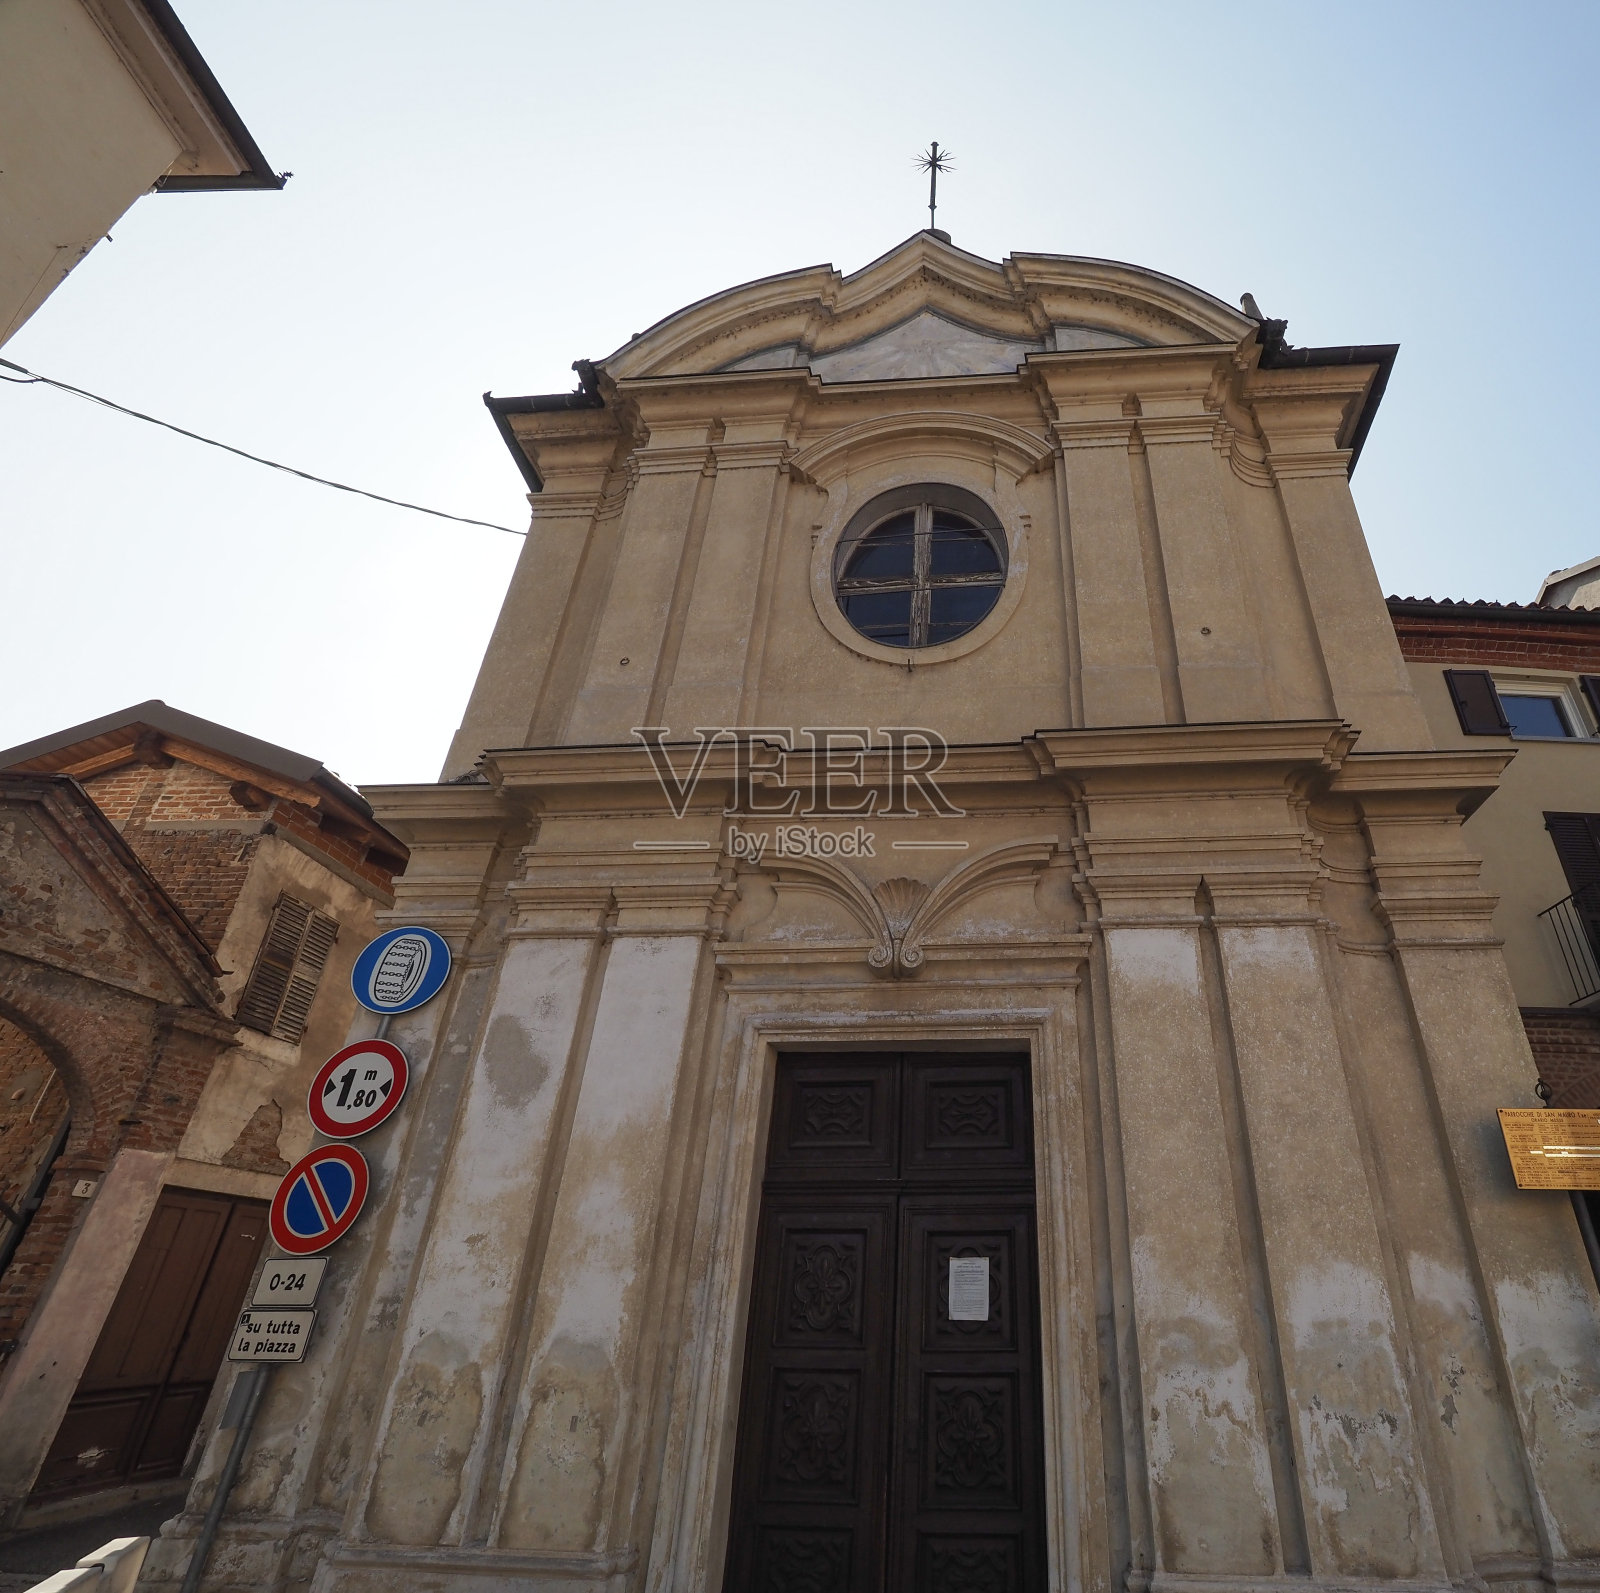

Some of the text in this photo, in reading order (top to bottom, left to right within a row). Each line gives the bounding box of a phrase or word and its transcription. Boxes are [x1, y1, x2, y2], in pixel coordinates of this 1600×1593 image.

[364, 1069, 378, 1081] m
[336, 1068, 377, 1111] 1,80
[269, 1273, 307, 1291] 0-24
[246, 1320, 301, 1335] su tutta
[238, 1338, 297, 1355] la piazza
